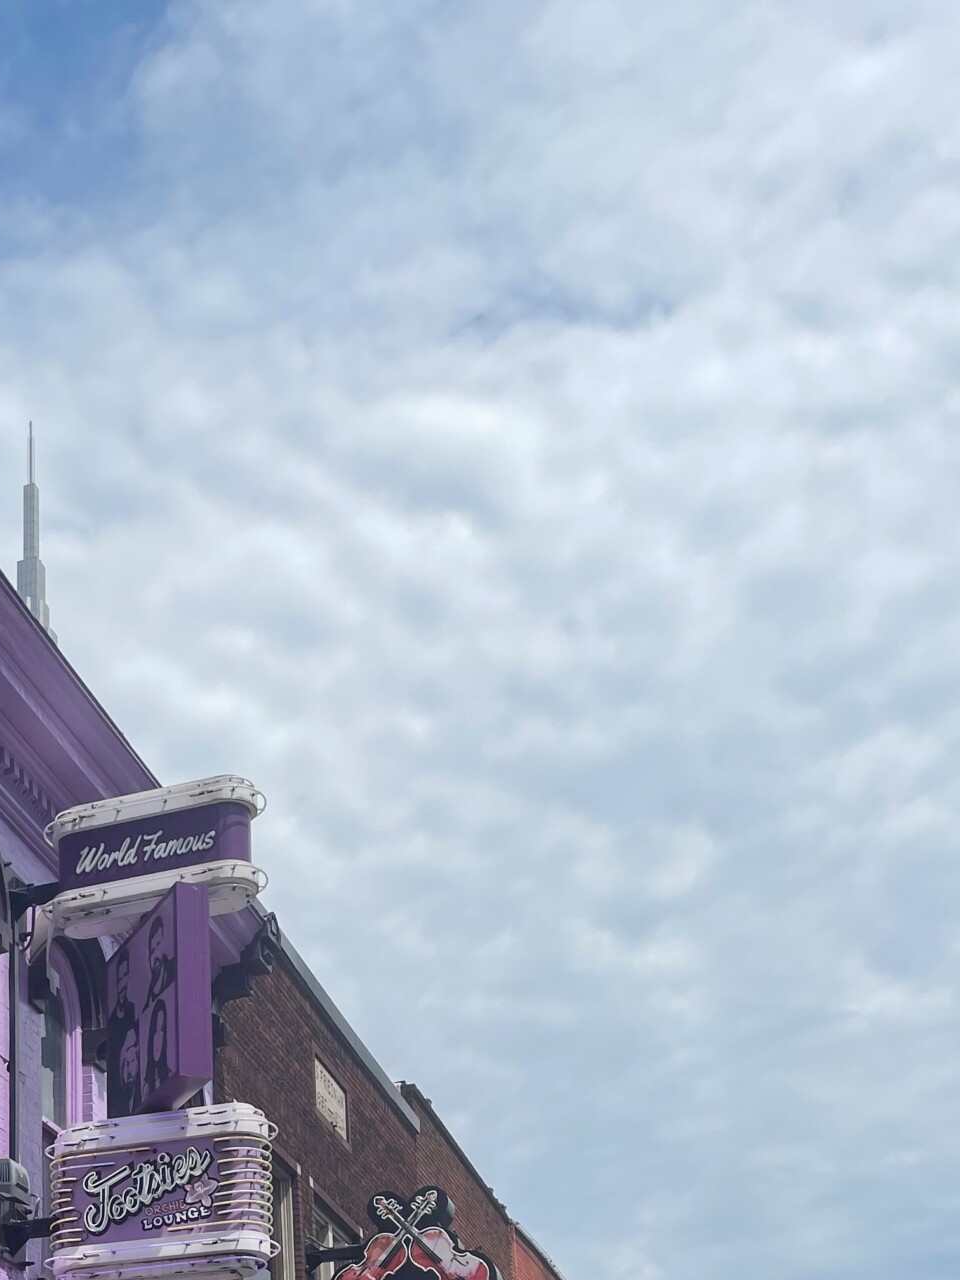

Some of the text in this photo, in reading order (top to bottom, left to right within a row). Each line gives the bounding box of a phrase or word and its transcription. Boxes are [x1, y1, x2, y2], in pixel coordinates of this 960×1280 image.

[75, 830, 216, 874] World Famous
[82, 1146, 213, 1234] Tootsies
[142, 1206, 211, 1230] LOUNGE
